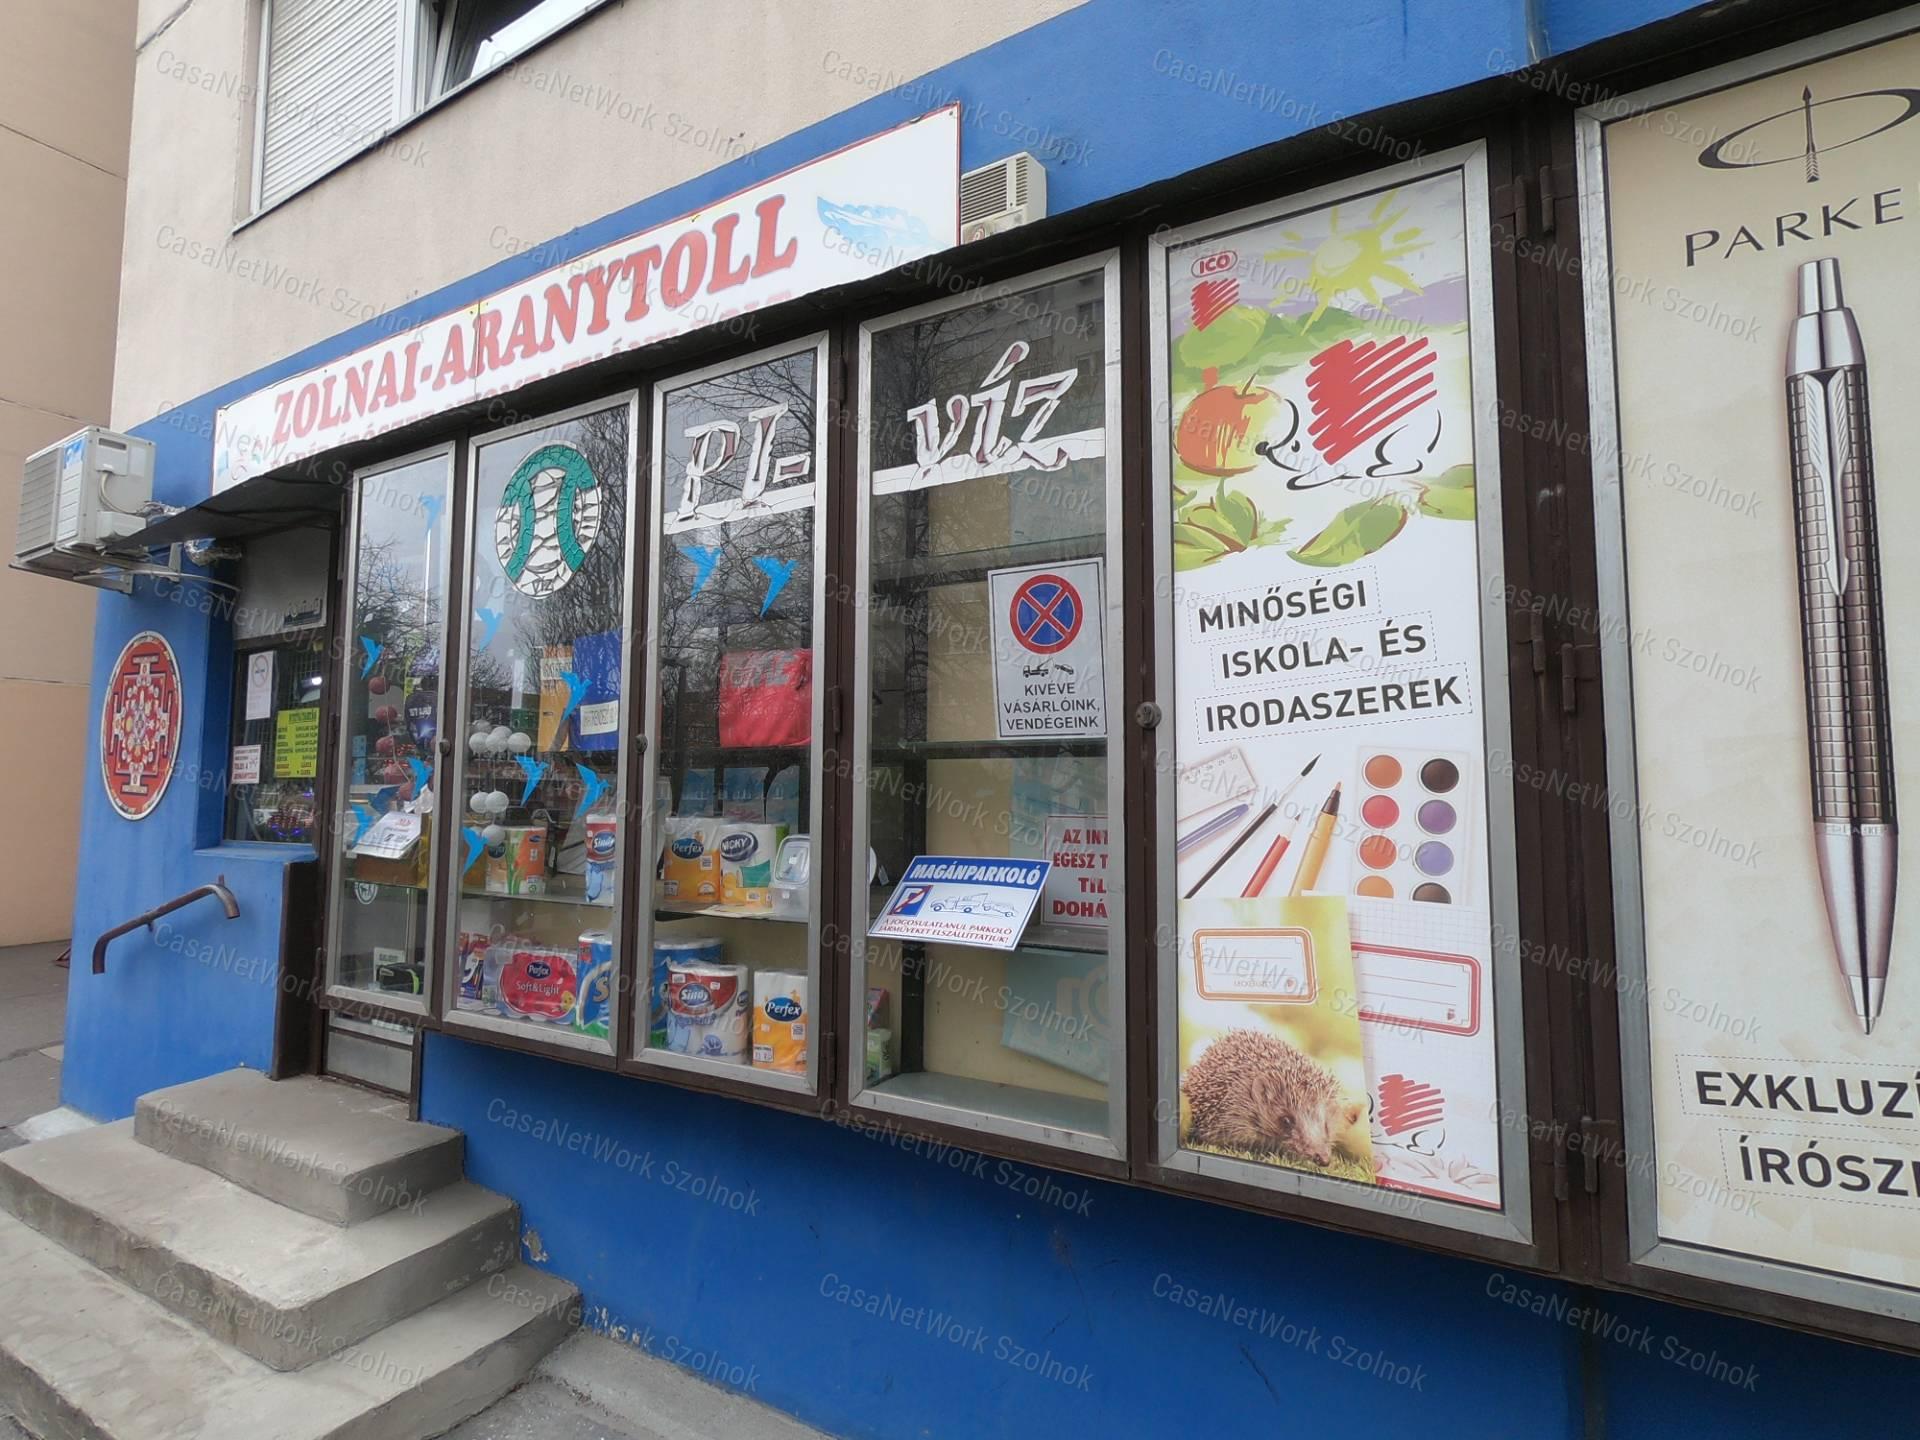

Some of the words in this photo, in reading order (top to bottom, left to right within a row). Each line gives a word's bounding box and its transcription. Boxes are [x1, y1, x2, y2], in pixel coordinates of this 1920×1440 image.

[1199, 254, 1231, 274] ICO
[271, 193, 798, 445] ZOLNAI-ARANYTOLL
[1199, 579, 1367, 633] MINŐSÉGI
[1222, 636, 1364, 679] ISKOLA-
[1380, 620, 1427, 658] ÉS
[1024, 680, 1076, 697] KIVÉVE
[1003, 696, 1101, 714] VÁSÁRLÓINK,
[1206, 675, 1462, 732] IRODASZEREK
[1006, 714, 1099, 731] VENDÉGEINK
[1063, 828, 1081, 844] AZ
[672, 841, 703, 857] Perfex
[1053, 849, 1095, 868] EGÉSZ
[910, 860, 1041, 886] MAGÁNPARKOLÓ
[1052, 898, 1109, 918] DOHÁ
[766, 1000, 802, 1017] Perfex
[1739, 1134, 1920, 1198] ÍRÓSZ
